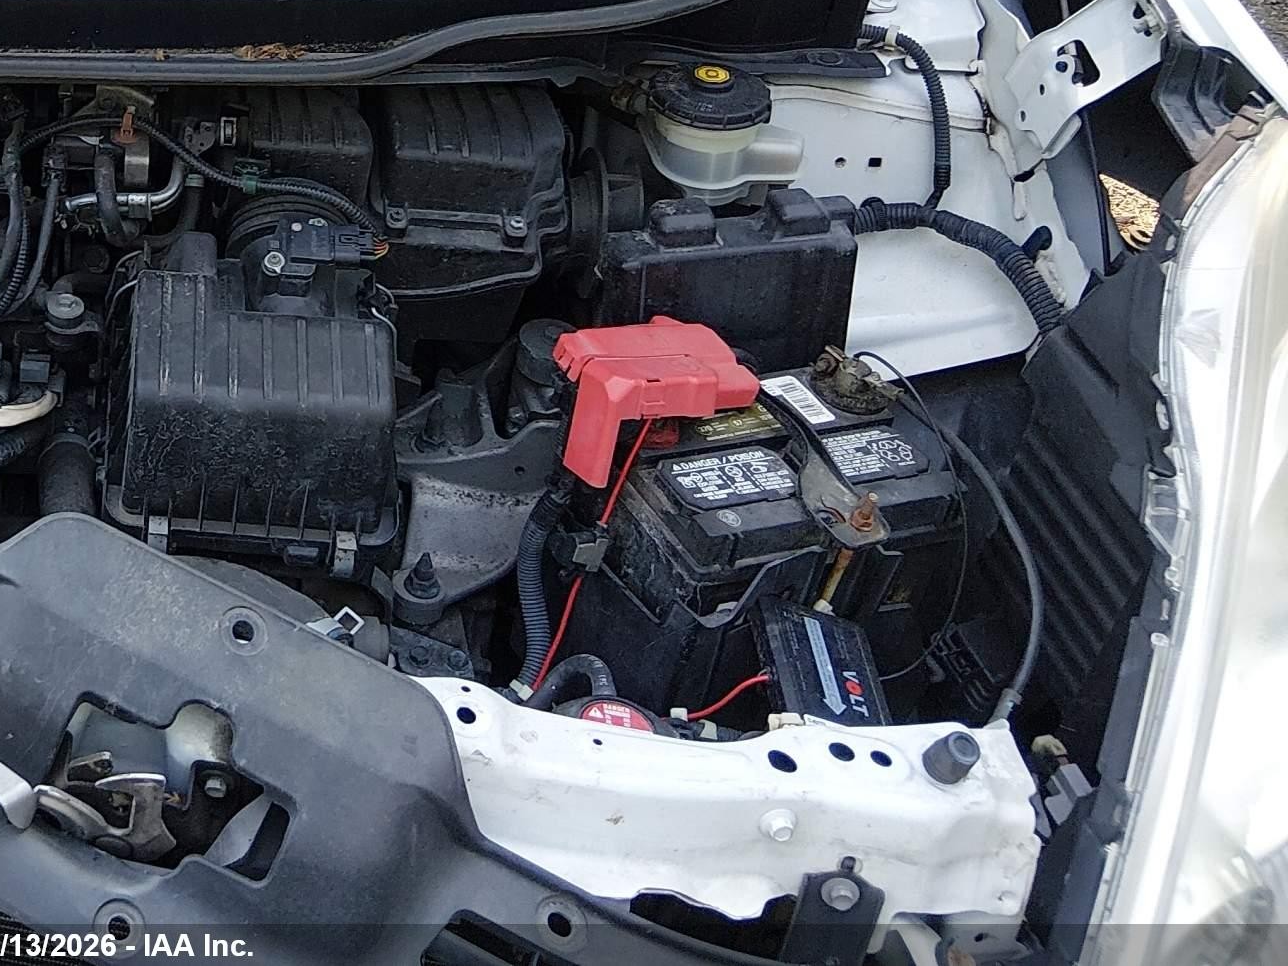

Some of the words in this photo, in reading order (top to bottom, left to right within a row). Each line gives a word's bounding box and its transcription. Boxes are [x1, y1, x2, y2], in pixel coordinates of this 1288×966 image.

[681, 458, 722, 470] DANGER
[727, 450, 766, 462] POISON
[842, 670, 870, 718] VOLT
